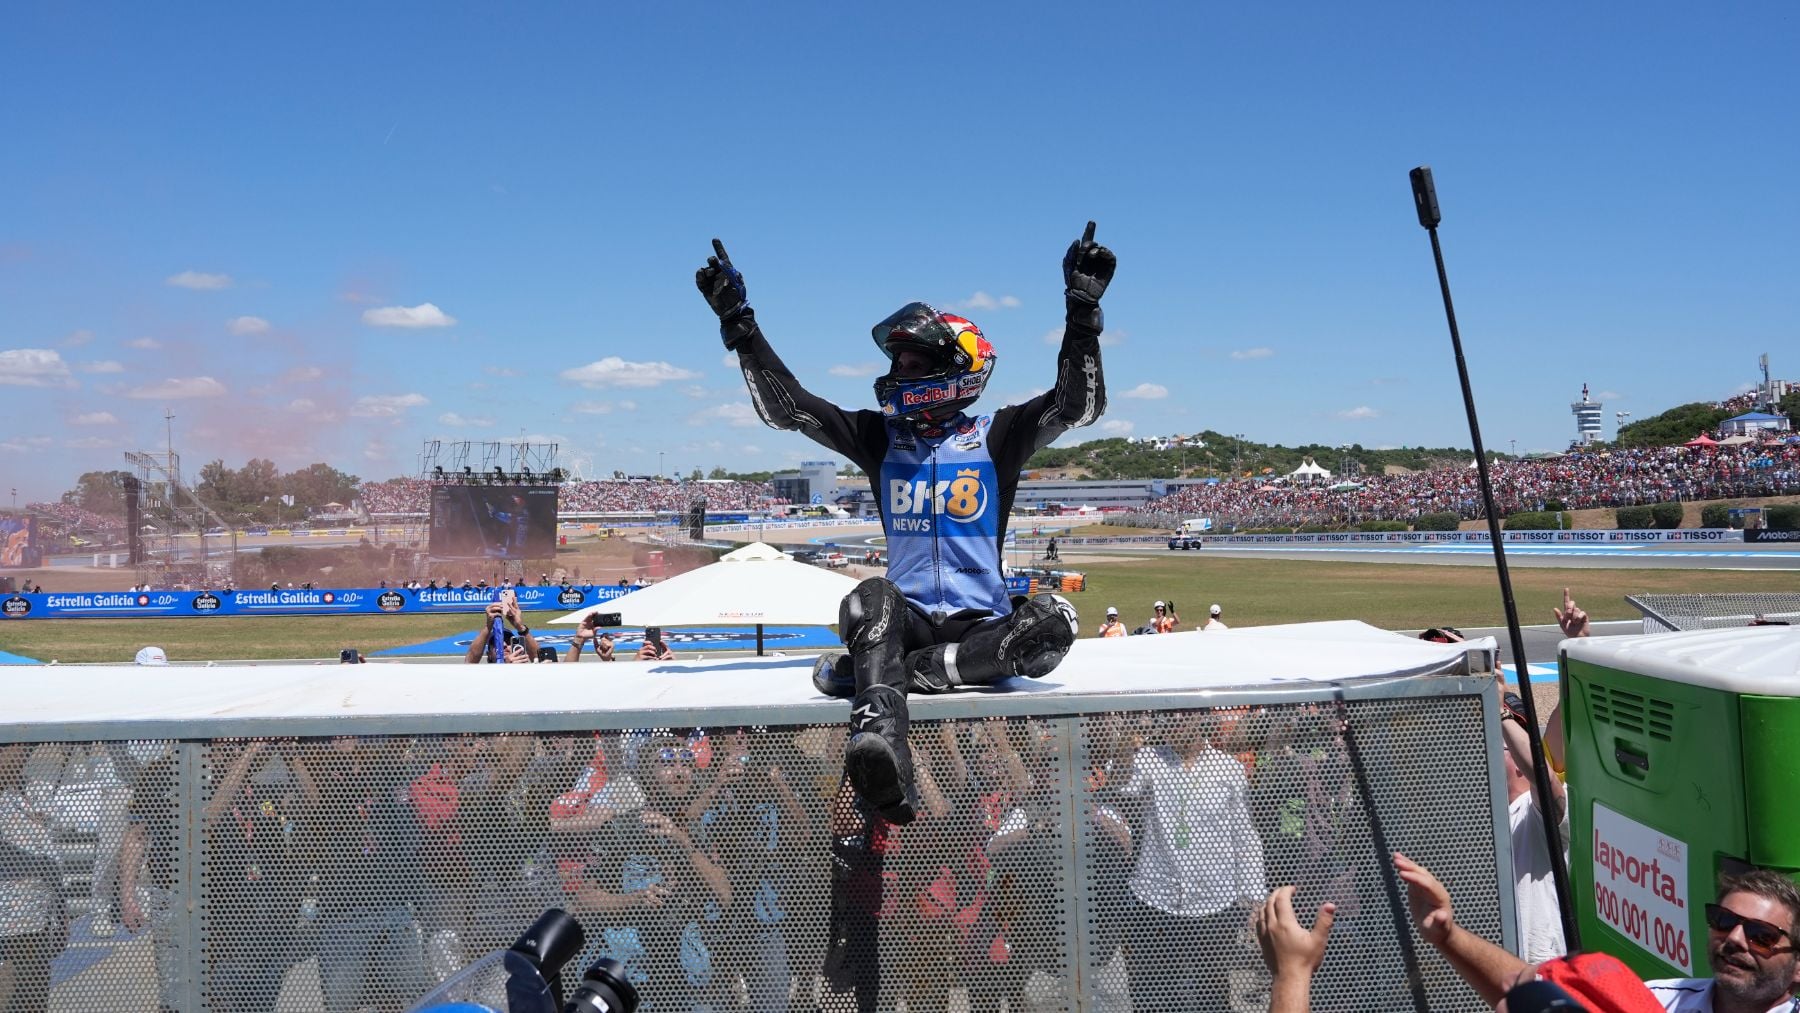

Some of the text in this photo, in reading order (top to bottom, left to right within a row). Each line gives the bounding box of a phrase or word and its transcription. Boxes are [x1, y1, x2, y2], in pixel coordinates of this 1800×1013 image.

[903, 388, 931, 405] Red
[932, 384, 957, 401] Bull
[890, 477, 980, 517] BK8
[893, 518, 931, 532] NEWS
[1522, 532, 1554, 540] TISSOT
[1571, 532, 1605, 540] TISSOT
[1624, 532, 1661, 540] TISSOT
[1683, 531, 1724, 540] TISSOT
[235, 592, 319, 604] Estrella Galicia
[419, 590, 502, 602] Estrella Galici
[598, 587, 632, 599] Estrel
[47, 594, 134, 607] Estrella Galicia
[1595, 828, 1684, 908] laporta.
[1595, 881, 1689, 967] 900 001 006
